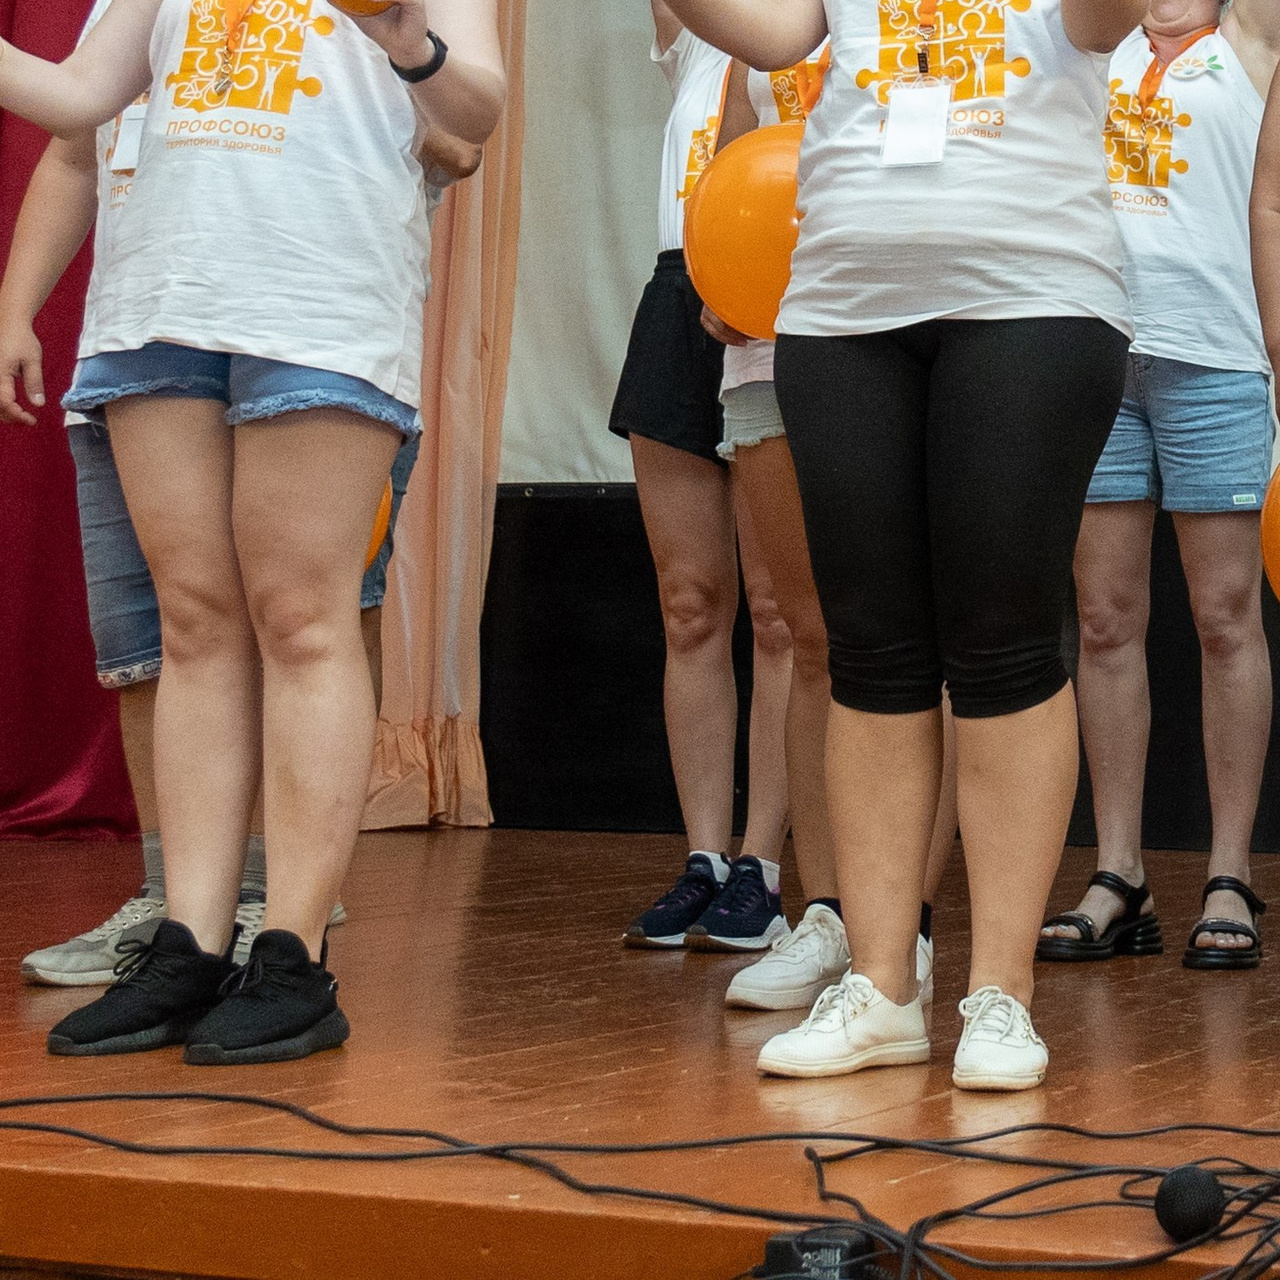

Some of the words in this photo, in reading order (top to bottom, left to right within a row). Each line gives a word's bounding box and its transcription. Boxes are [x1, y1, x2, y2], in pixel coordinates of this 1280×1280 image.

[165, 118, 286, 142] ПРОФСОЮЗ
[951, 127, 1002, 139] ДОРОВЬЯ
[166, 138, 220, 150] ТЕРРИТОРИЯ
[222, 140, 283, 156] ЗДОРОВЬЯ
[1111, 191, 1168, 208] ФСОЮЗ
